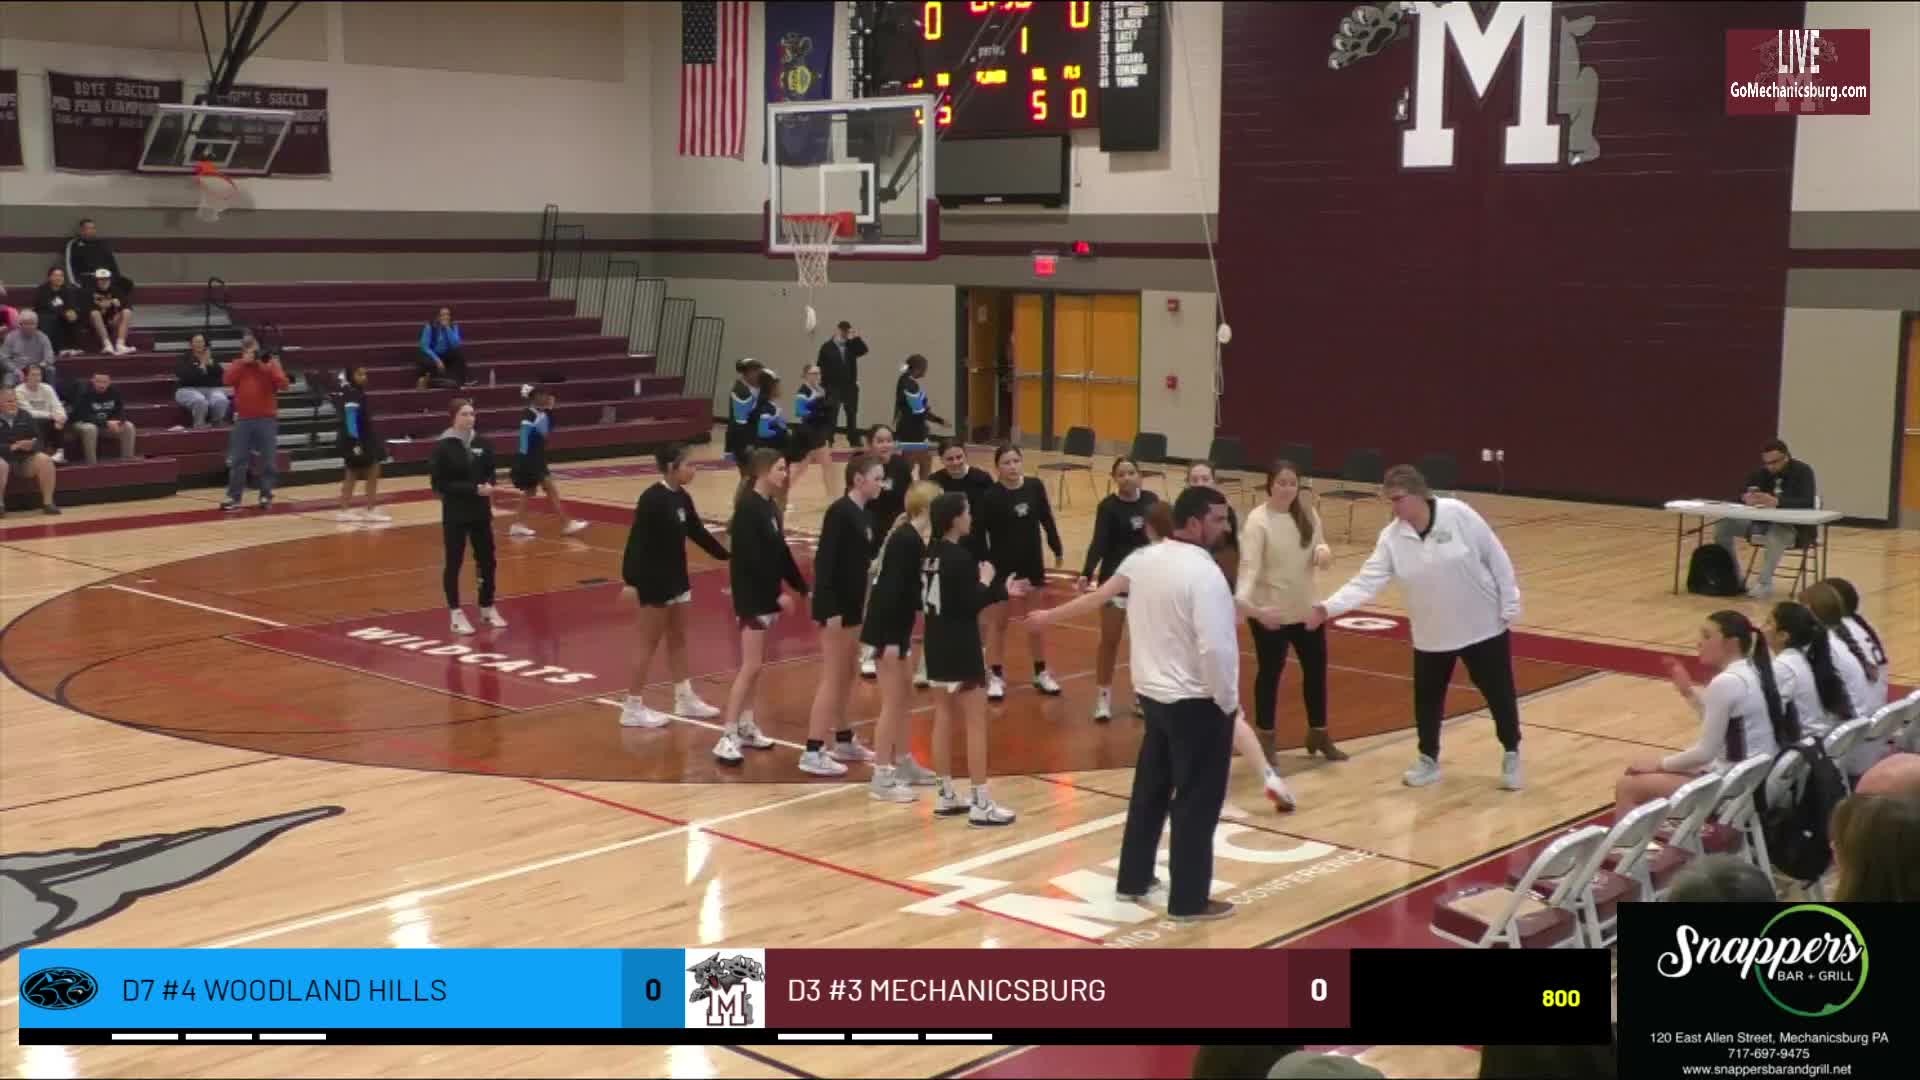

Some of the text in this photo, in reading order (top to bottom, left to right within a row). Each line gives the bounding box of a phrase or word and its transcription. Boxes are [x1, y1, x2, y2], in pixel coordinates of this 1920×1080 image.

[924, 1, 941, 40] 0
[1071, 87, 1087, 118] 0
[1403, 1, 1561, 167] M
[1032, 89, 1047, 120] 5
[347, 627, 597, 684] WILDCATS
